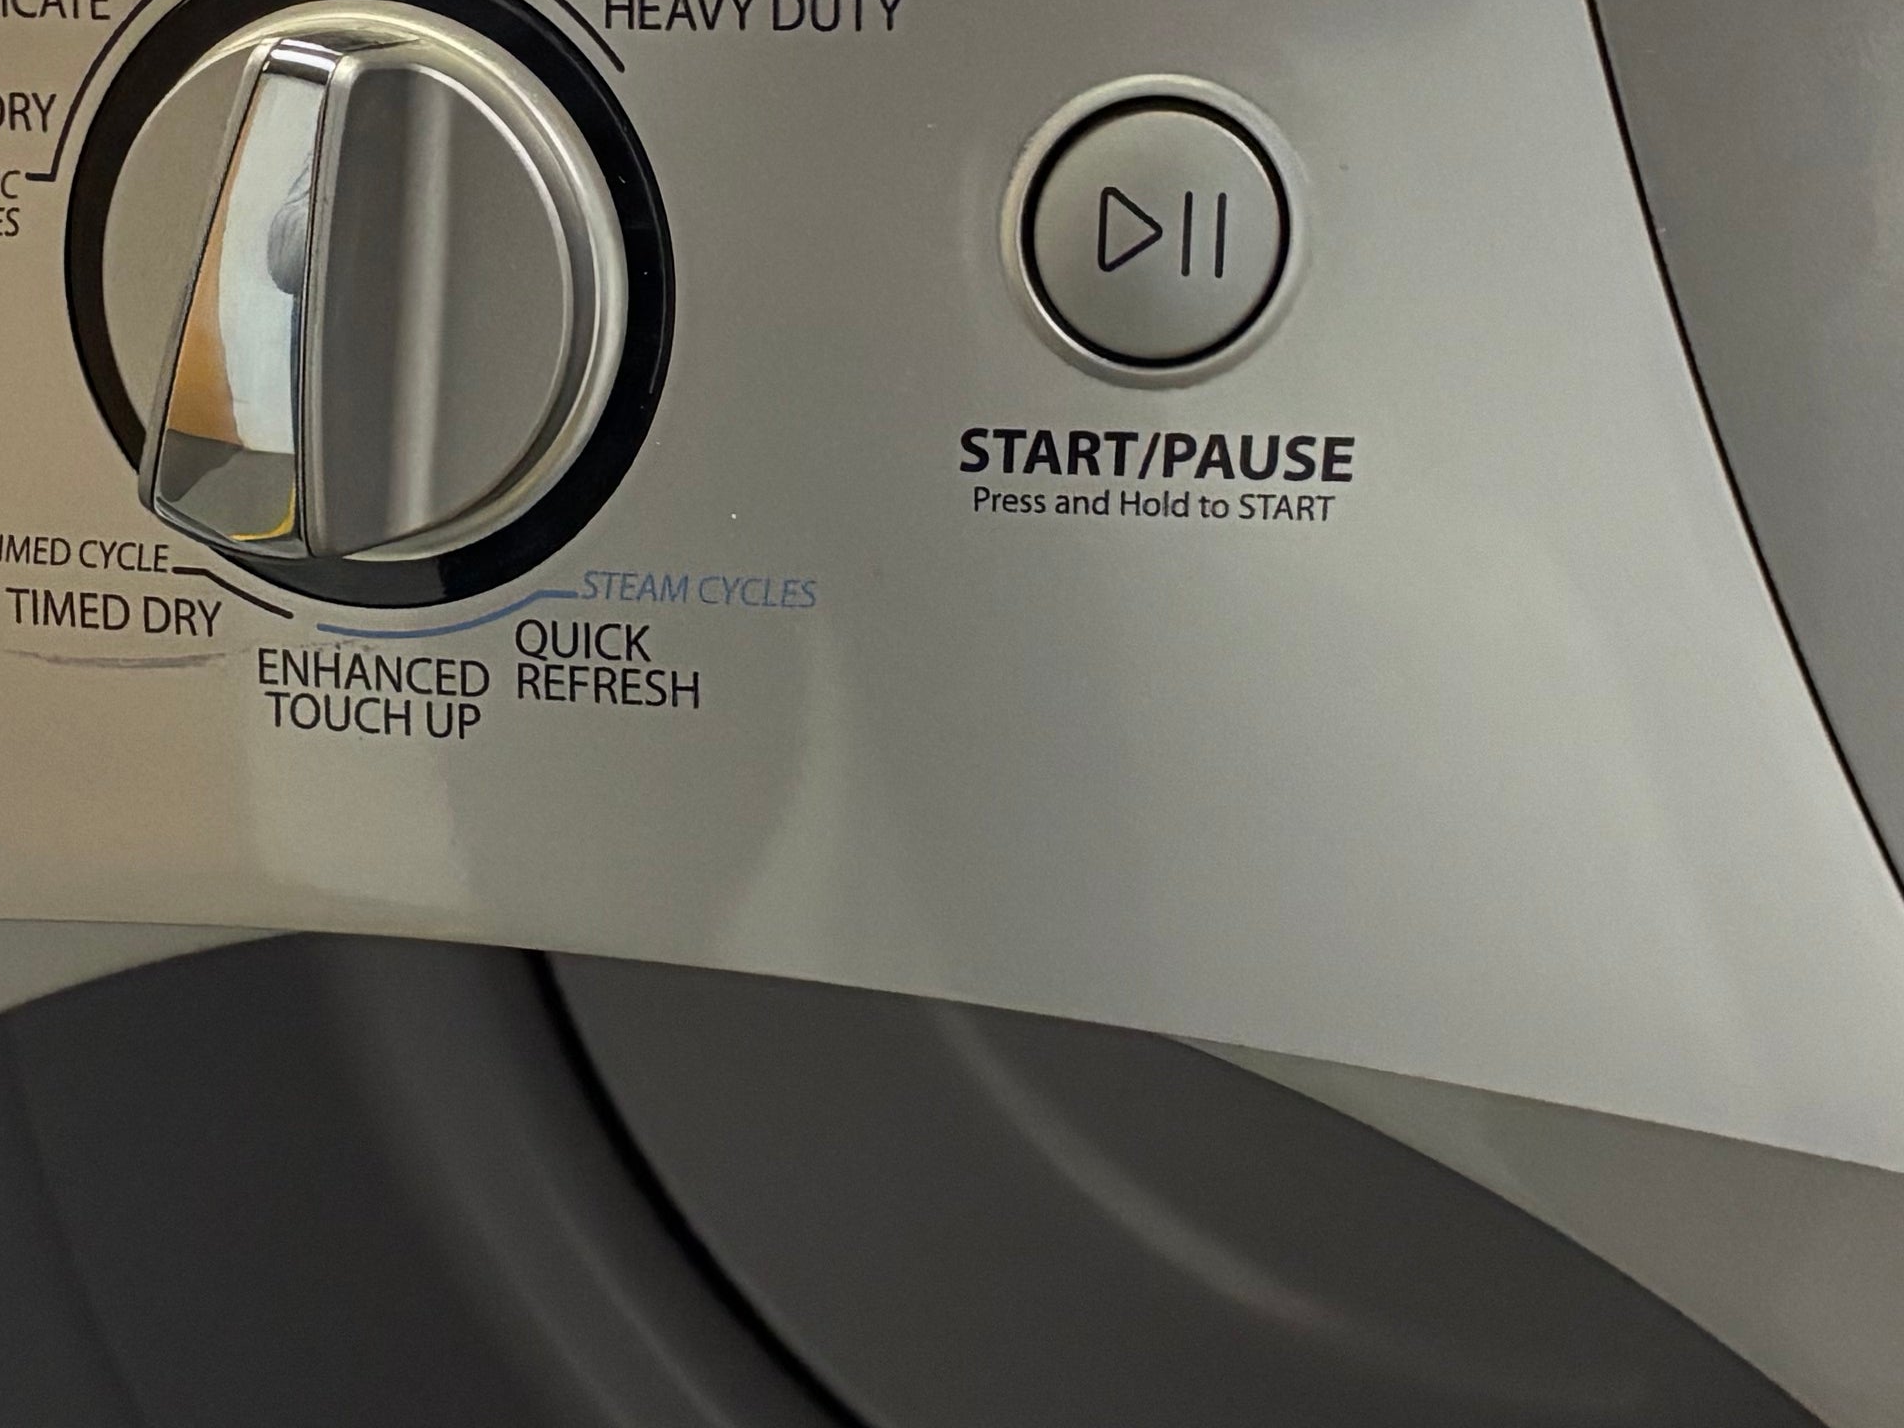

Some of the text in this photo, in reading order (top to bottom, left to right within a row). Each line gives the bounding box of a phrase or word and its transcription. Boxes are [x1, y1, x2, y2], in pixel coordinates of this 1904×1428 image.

[960, 428, 1355, 482] START/PAUSE
[974, 486, 1335, 521] Press and Hold to START
[79, 540, 168, 573] CYCLE
[581, 570, 816, 608] STEAM CYCLES
[6, 587, 221, 637] TIMED DRY
[516, 619, 650, 661] QUICK
[259, 648, 489, 697] ENHANCED
[518, 663, 699, 708] REFRESH
[266, 691, 482, 739] TOUCH UP
